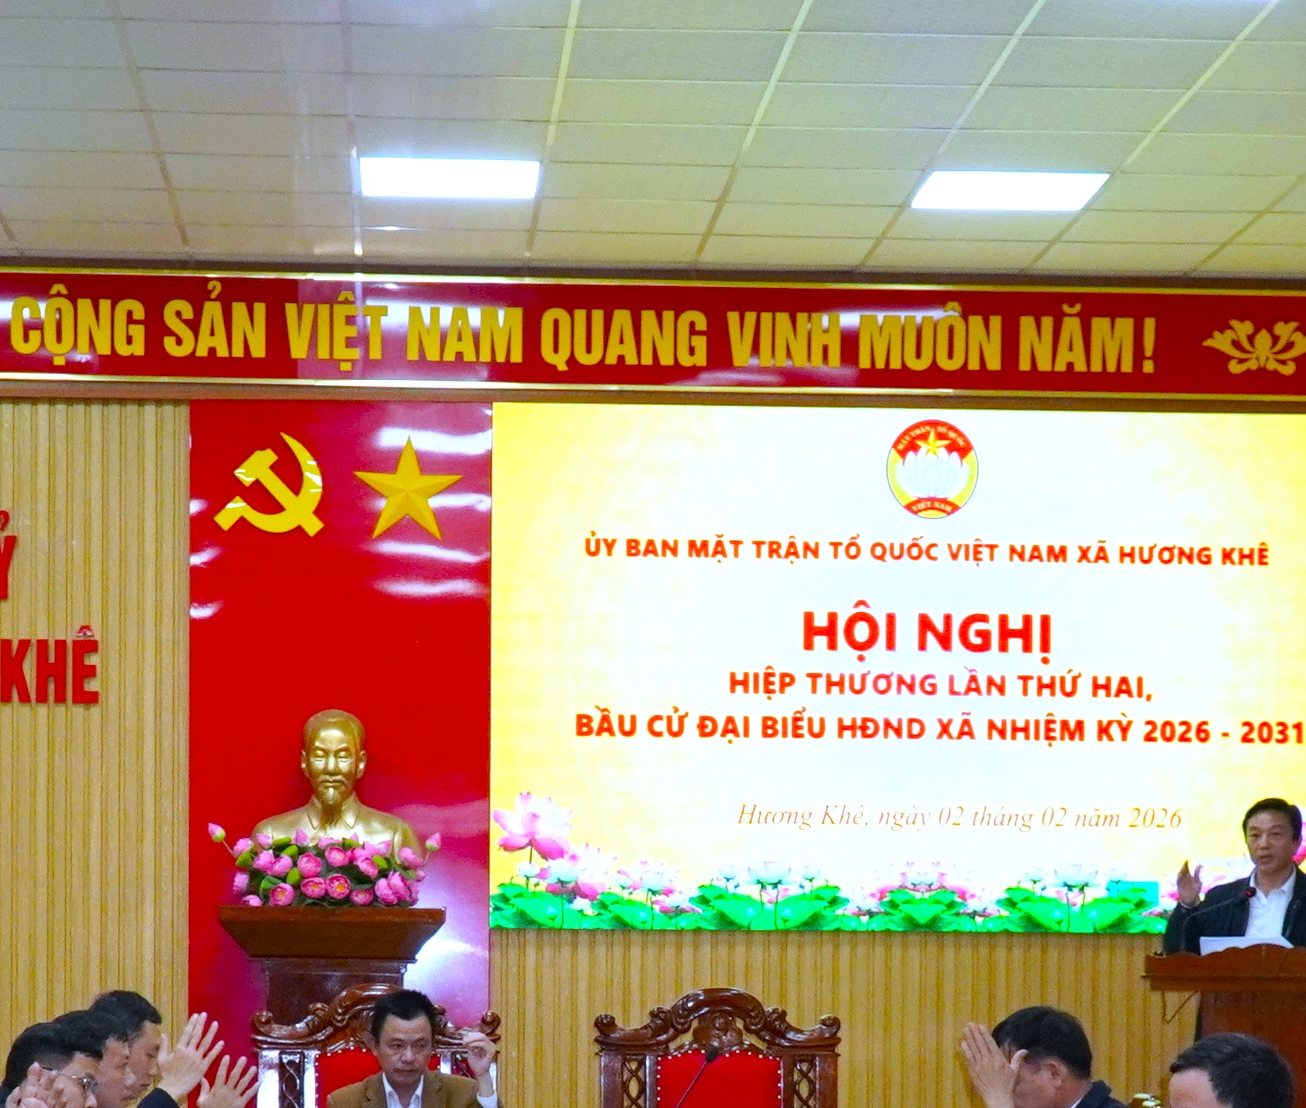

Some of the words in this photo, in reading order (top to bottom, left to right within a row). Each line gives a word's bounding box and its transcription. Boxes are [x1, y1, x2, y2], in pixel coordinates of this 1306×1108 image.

[10, 283, 145, 366] CỘNG
[163, 280, 266, 359] SẢN
[285, 290, 388, 372] VIỆT
[406, 305, 523, 364] NAM
[540, 307, 707, 372] QUANG
[727, 311, 841, 369] VINH
[859, 301, 1002, 371] MUÔN
[585, 531, 617, 557] ỦY
[626, 538, 679, 557] BAN
[688, 534, 743, 563] MẶT
[752, 535, 820, 565] TRẬN
[829, 533, 862, 560] TỔ
[870, 536, 939, 562] QUỐC
[947, 538, 999, 567] VIỆT
[1009, 545, 1068, 563] NAM
[1077, 540, 1110, 563] XÃ
[1119, 543, 1212, 565] HƯƠNG
[1221, 542, 1270, 566] KHÊ
[803, 599, 896, 662] HỘI
[918, 612, 1052, 665] NGHỊ
[0, 624, 99, 705] KHÊ
[729, 665, 796, 701] HIỆP
[806, 670, 938, 696] THƯƠNG
[949, 665, 1006, 696] LẦN
[1017, 668, 1082, 698] THỨ
[1091, 675, 1153, 702] HAI,
[575, 705, 637, 737] BẦU
[647, 706, 689, 738] CỬ
[696, 715, 750, 744] ĐẠI
[761, 706, 826, 739] BIỂU
[837, 717, 926, 740] HĐND
[936, 711, 976, 740] XÃ
[987, 712, 1085, 747] NHIỆM
[1097, 713, 1133, 742] KỲ
[1143, 719, 1210, 743] 2026
[1240, 721, 1304, 744] 2031
[737, 804, 813, 830] Hương
[878, 805, 931, 831] ngày
[938, 806, 965, 826] 02
[972, 806, 1034, 832] tháng
[1041, 806, 1067, 827] 02
[1075, 808, 1121, 828] năm
[1128, 807, 1184, 828] 2026
